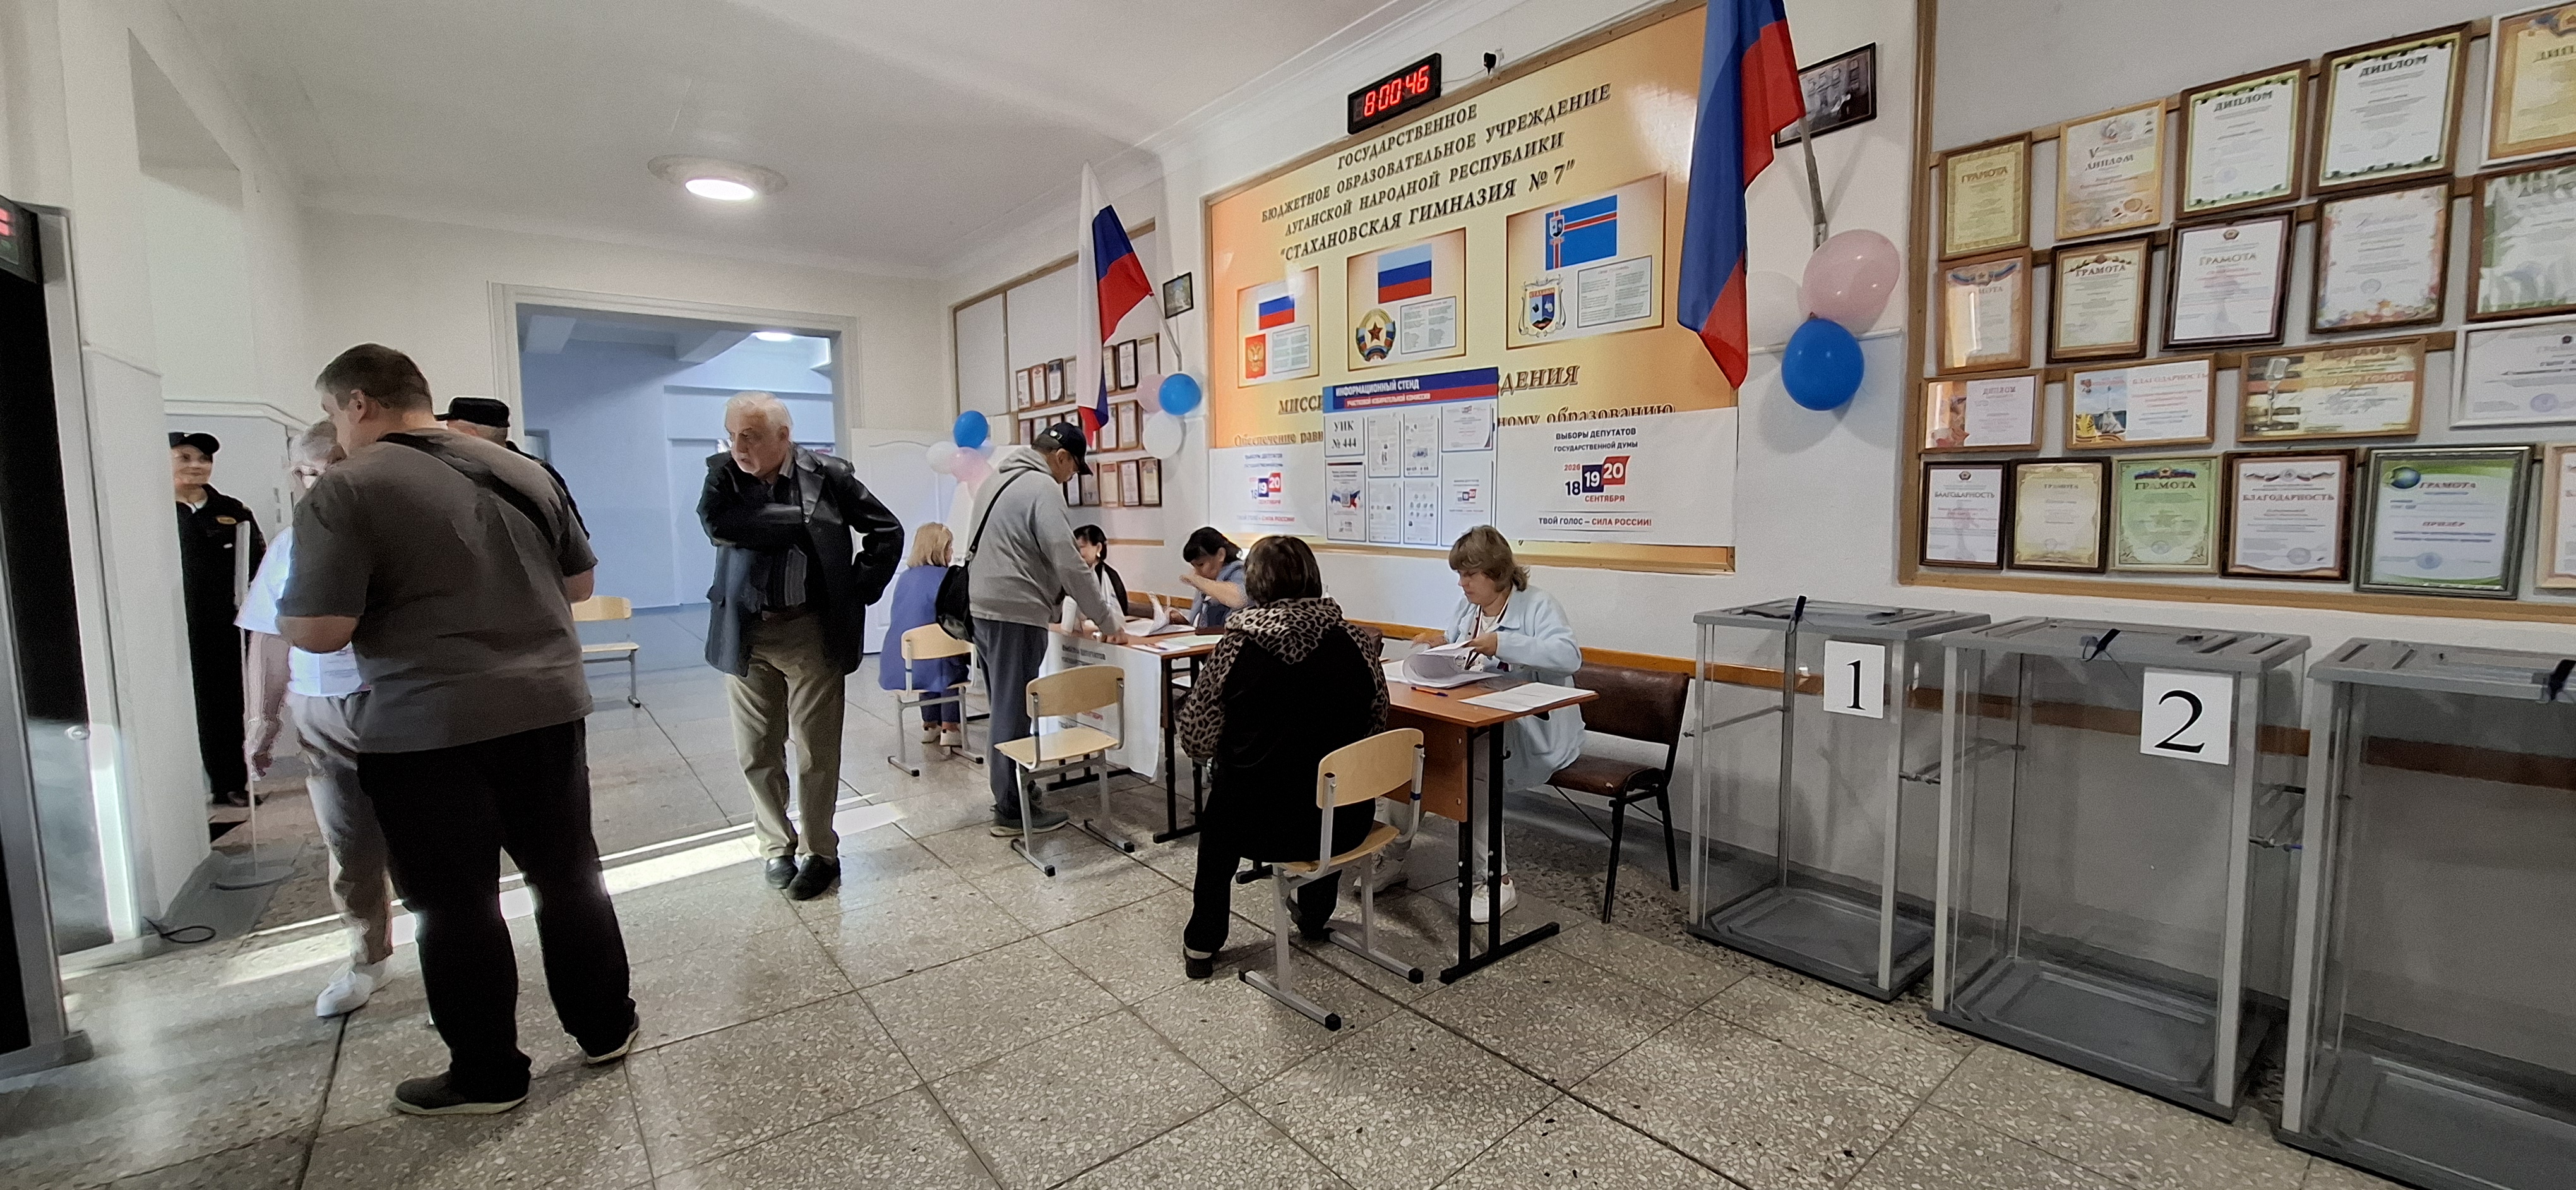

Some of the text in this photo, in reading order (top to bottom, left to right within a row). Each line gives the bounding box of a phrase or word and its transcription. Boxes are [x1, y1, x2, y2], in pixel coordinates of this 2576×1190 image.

[2358, 54, 2428, 78] ДИПЛОМ
[2214, 90, 2273, 112] ДИПЛОМ
[1338, 104, 1477, 169] ГОСУДАРСТВЕННОЕ
[1262, 83, 1611, 222] БЮДЖЕТНОЕ ОБРАЗОВАТЕЛЬНОЕ УЧРЕЖДЕНИЕ
[2085, 155, 2134, 171] ДИПЛОМ
[1285, 131, 1565, 236] ЛУГАНСКОЙ НАРОДНОЙ РЕСПУБЛИКИ
[1408, 178, 1517, 225] ГИМНАЗИЯ
[1529, 171, 1548, 193] №
[2198, 253, 2257, 267] ГРАМОТА
[2075, 265, 2126, 277] ГРАМОТА
[1336, 379, 1420, 397] ИНФОРМАЦИОННЫЙ СТЕНД
[1498, 366, 1580, 396] ДЕНИЯ
[1333, 420, 1354, 432] УИК
[1556, 428, 1637, 440] ВЫБОРЫ ДЕПУТАТОВ
[1301, 431, 1323, 444] равн
[1342, 438, 1357, 448] 444
[1554, 441, 1638, 452] ГОСУДАРСТВЕННОЙ ДУМЫ
[1268, 477, 1280, 489] 20
[1565, 462, 1625, 496] 18 19 20
[2135, 481, 2197, 490] ГРАМОТА
[1585, 495, 1625, 503] СЕНТЯБРЯ
[1539, 515, 1558, 525] ТВОЙ
[1592, 517, 1613, 526] СИЛА
[1614, 518, 1652, 526] РОССИИ!
[1846, 659, 1868, 711] 1
[2154, 689, 2206, 754] 2
